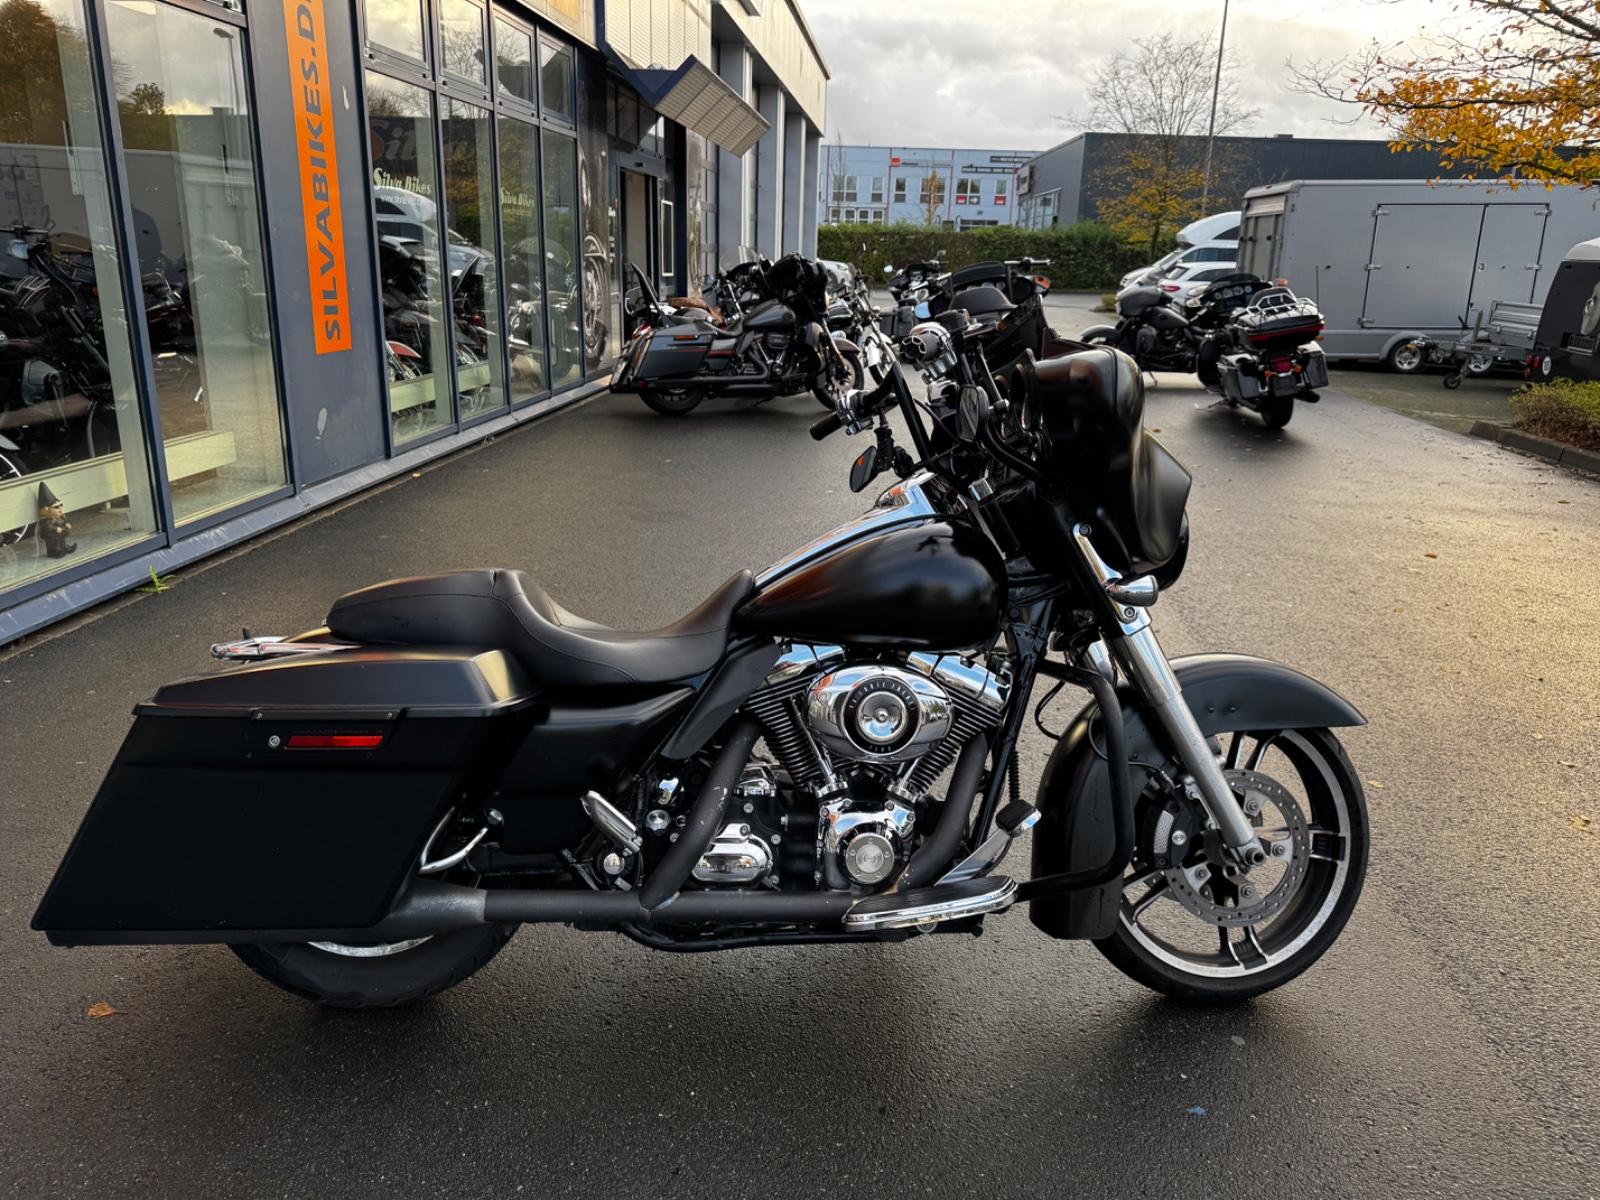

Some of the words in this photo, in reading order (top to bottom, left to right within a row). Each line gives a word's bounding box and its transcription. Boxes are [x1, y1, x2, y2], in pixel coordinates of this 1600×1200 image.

[296, 0, 342, 341] SILVABIKES.D
[373, 167, 403, 189] Silva
[404, 175, 433, 195] Bikes
